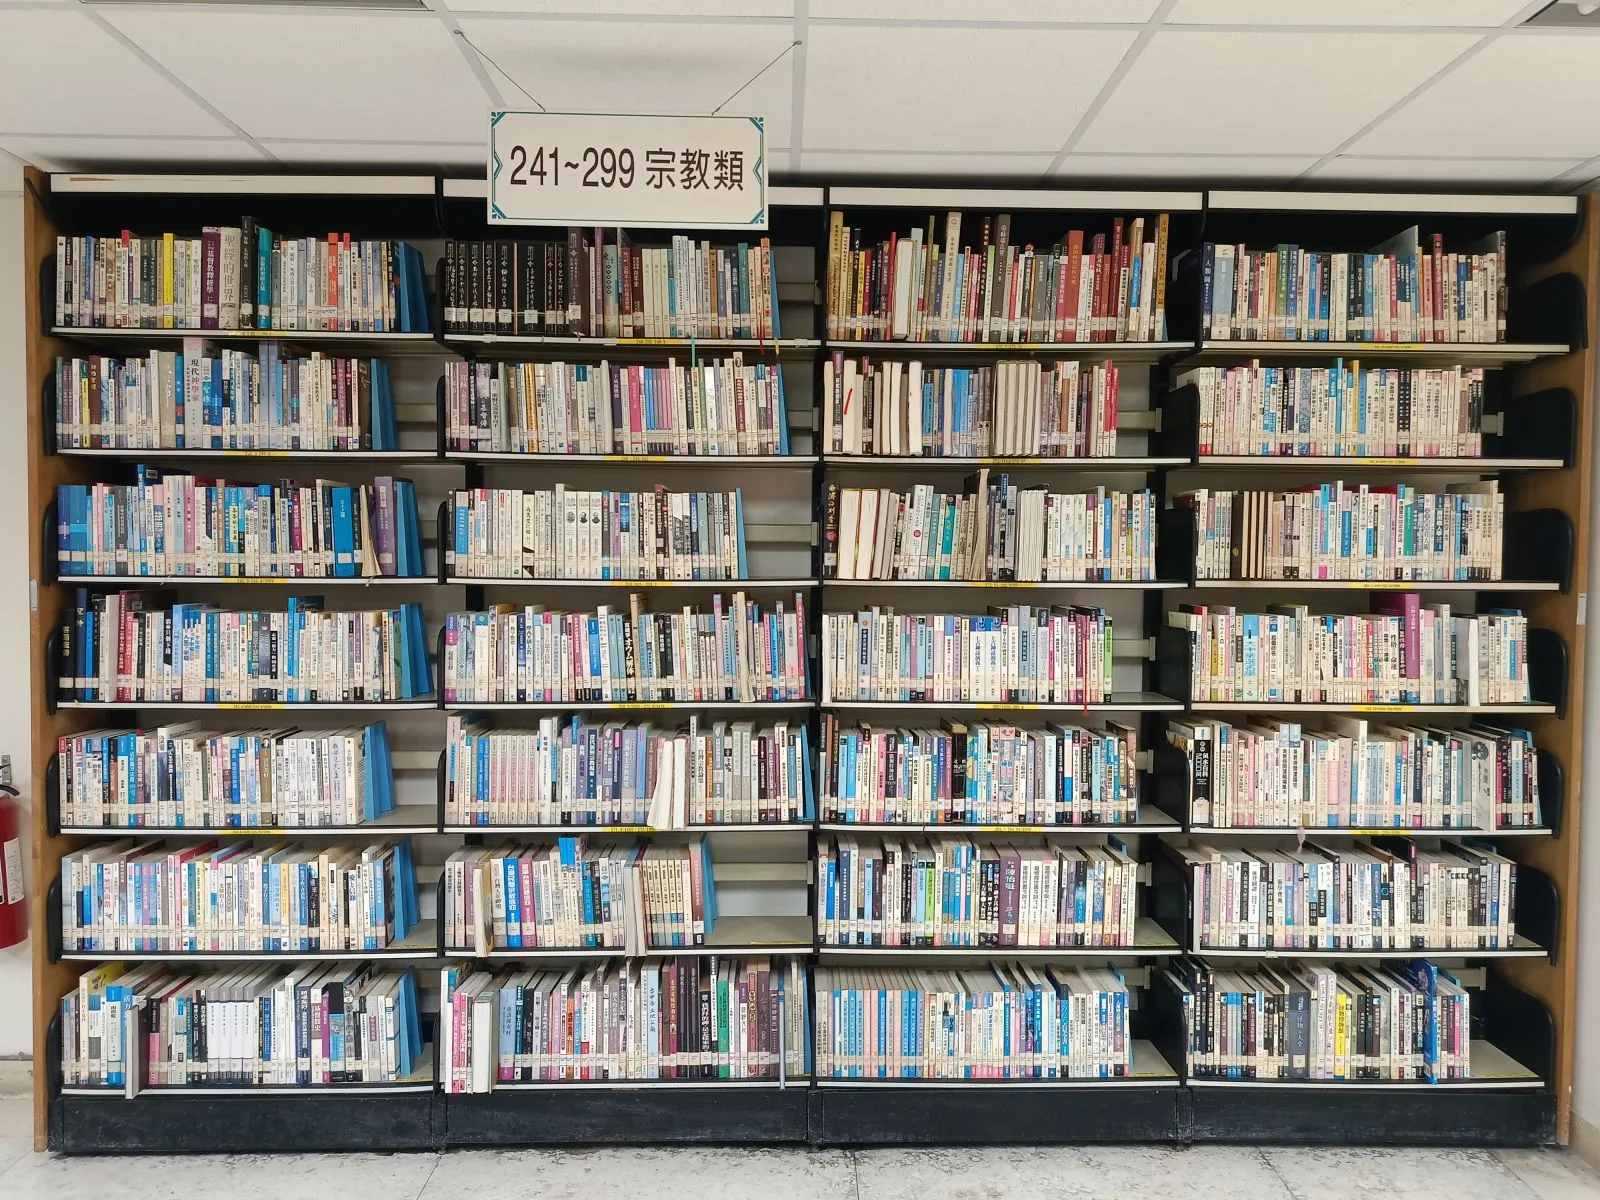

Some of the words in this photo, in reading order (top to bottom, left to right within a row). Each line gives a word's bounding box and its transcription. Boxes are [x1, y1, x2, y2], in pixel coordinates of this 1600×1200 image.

[509, 145, 635, 188] 241~299
[645, 147, 744, 191] 宗教類
[223, 234, 235, 302] 聖經的世界
[190, 359, 200, 402] 現代神學家
